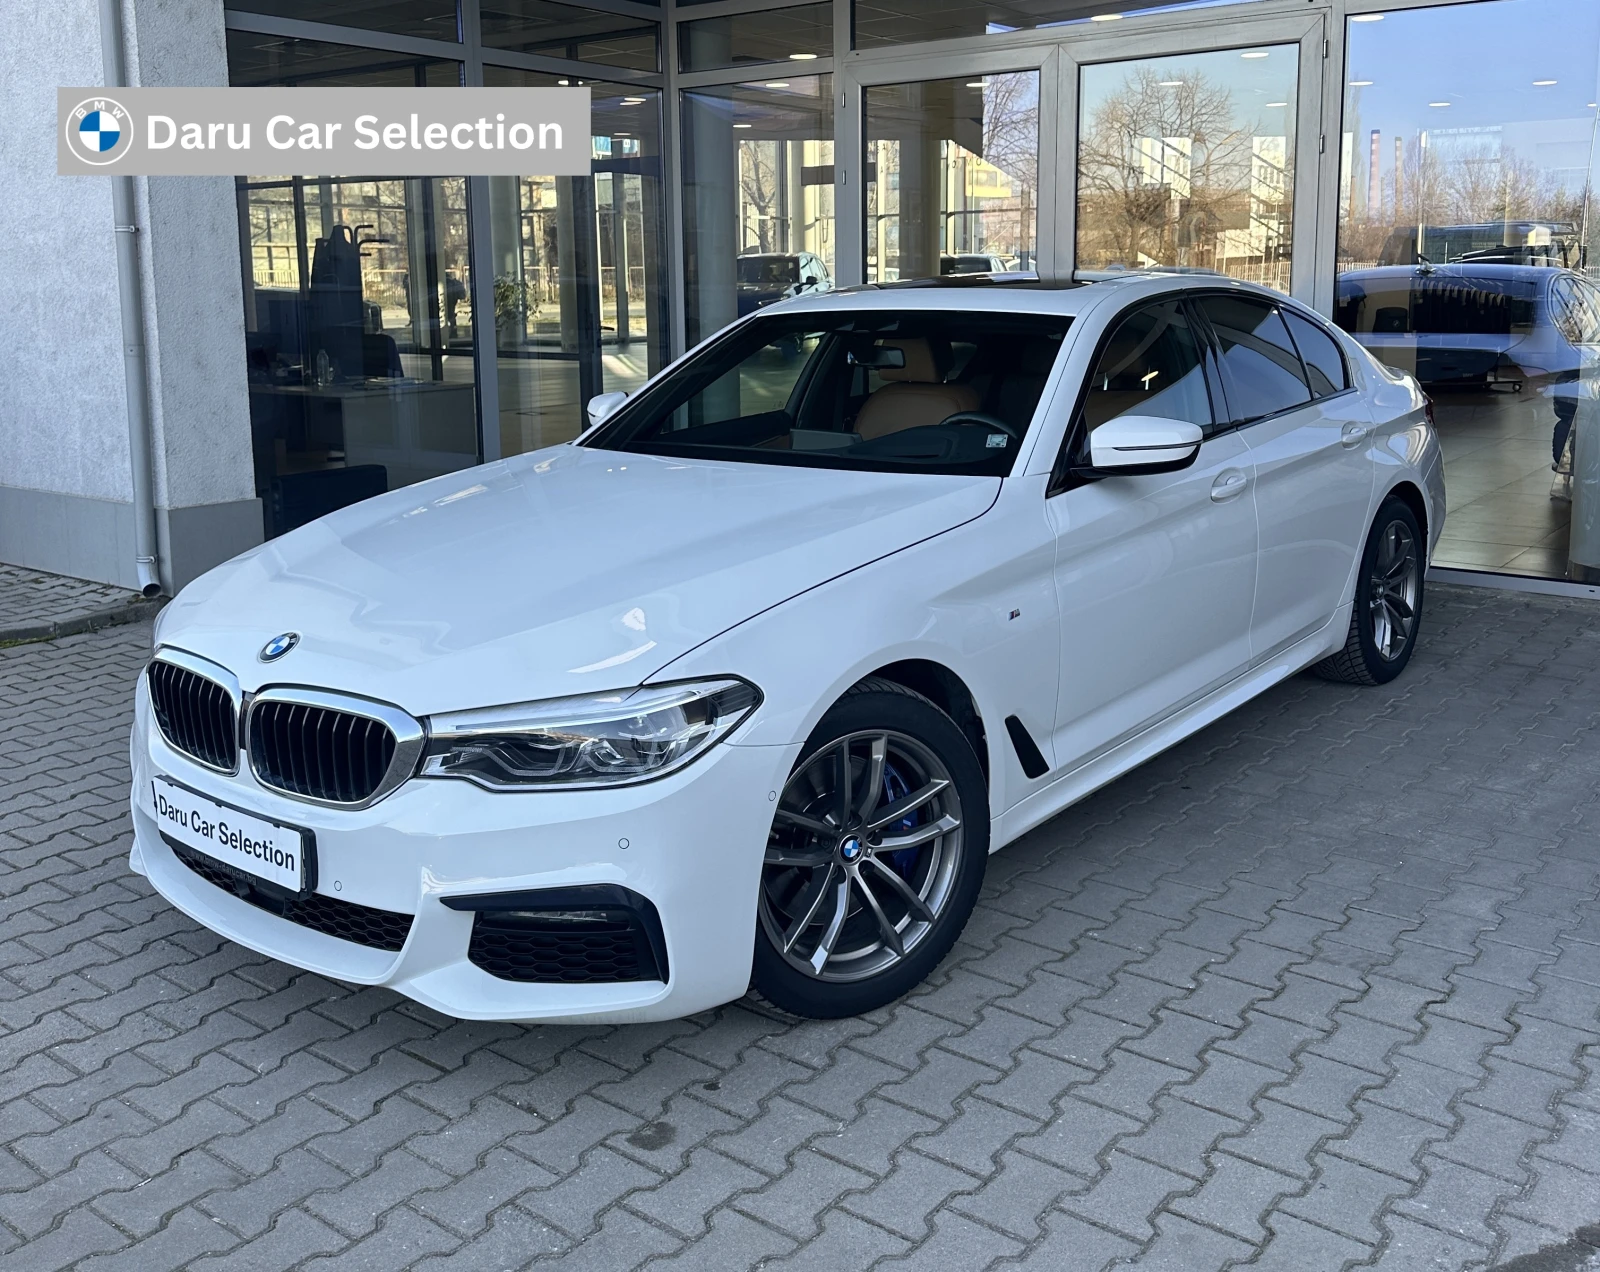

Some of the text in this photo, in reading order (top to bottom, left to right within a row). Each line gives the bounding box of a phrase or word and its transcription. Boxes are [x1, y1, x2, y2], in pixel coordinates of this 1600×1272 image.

[159, 794, 295, 871] Daru Car Selection
